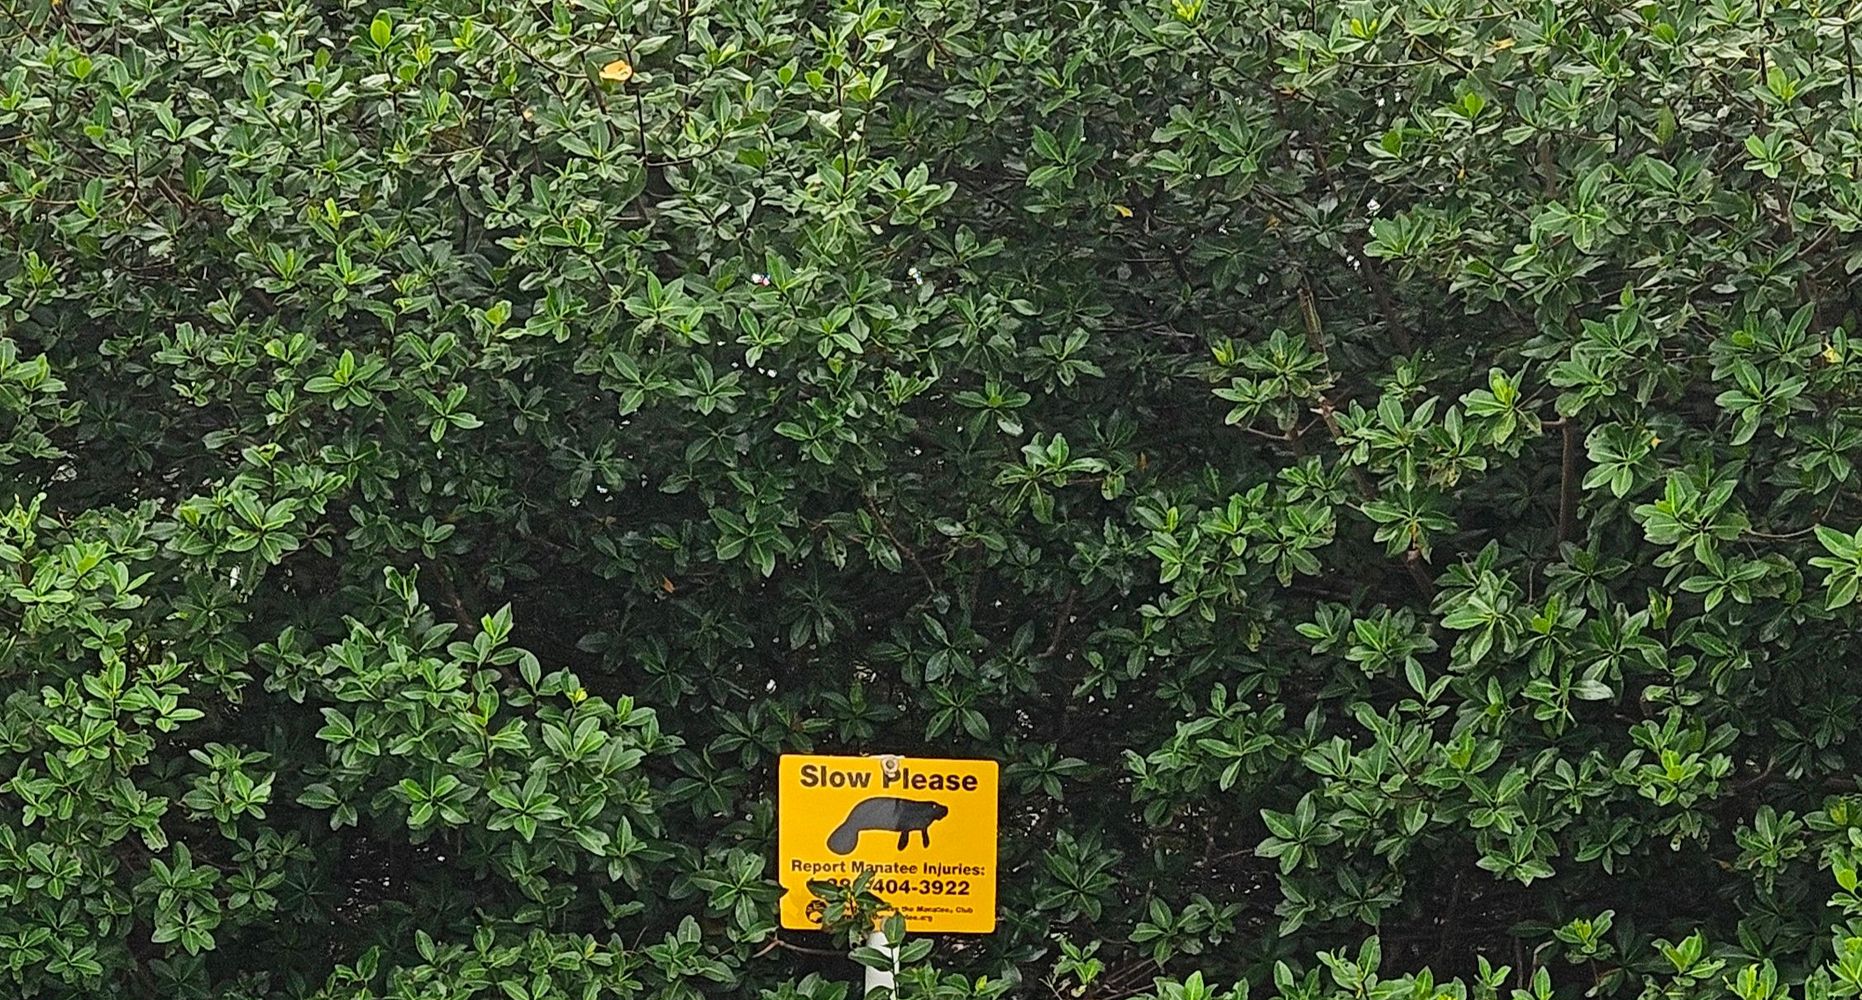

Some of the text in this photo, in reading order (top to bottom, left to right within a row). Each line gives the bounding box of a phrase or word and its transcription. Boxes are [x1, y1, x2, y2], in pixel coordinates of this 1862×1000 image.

[800, 764, 978, 791] Slow Please
[791, 859, 985, 877] Report Manatee Injuries:
[955, 906, 974, 914] Club
